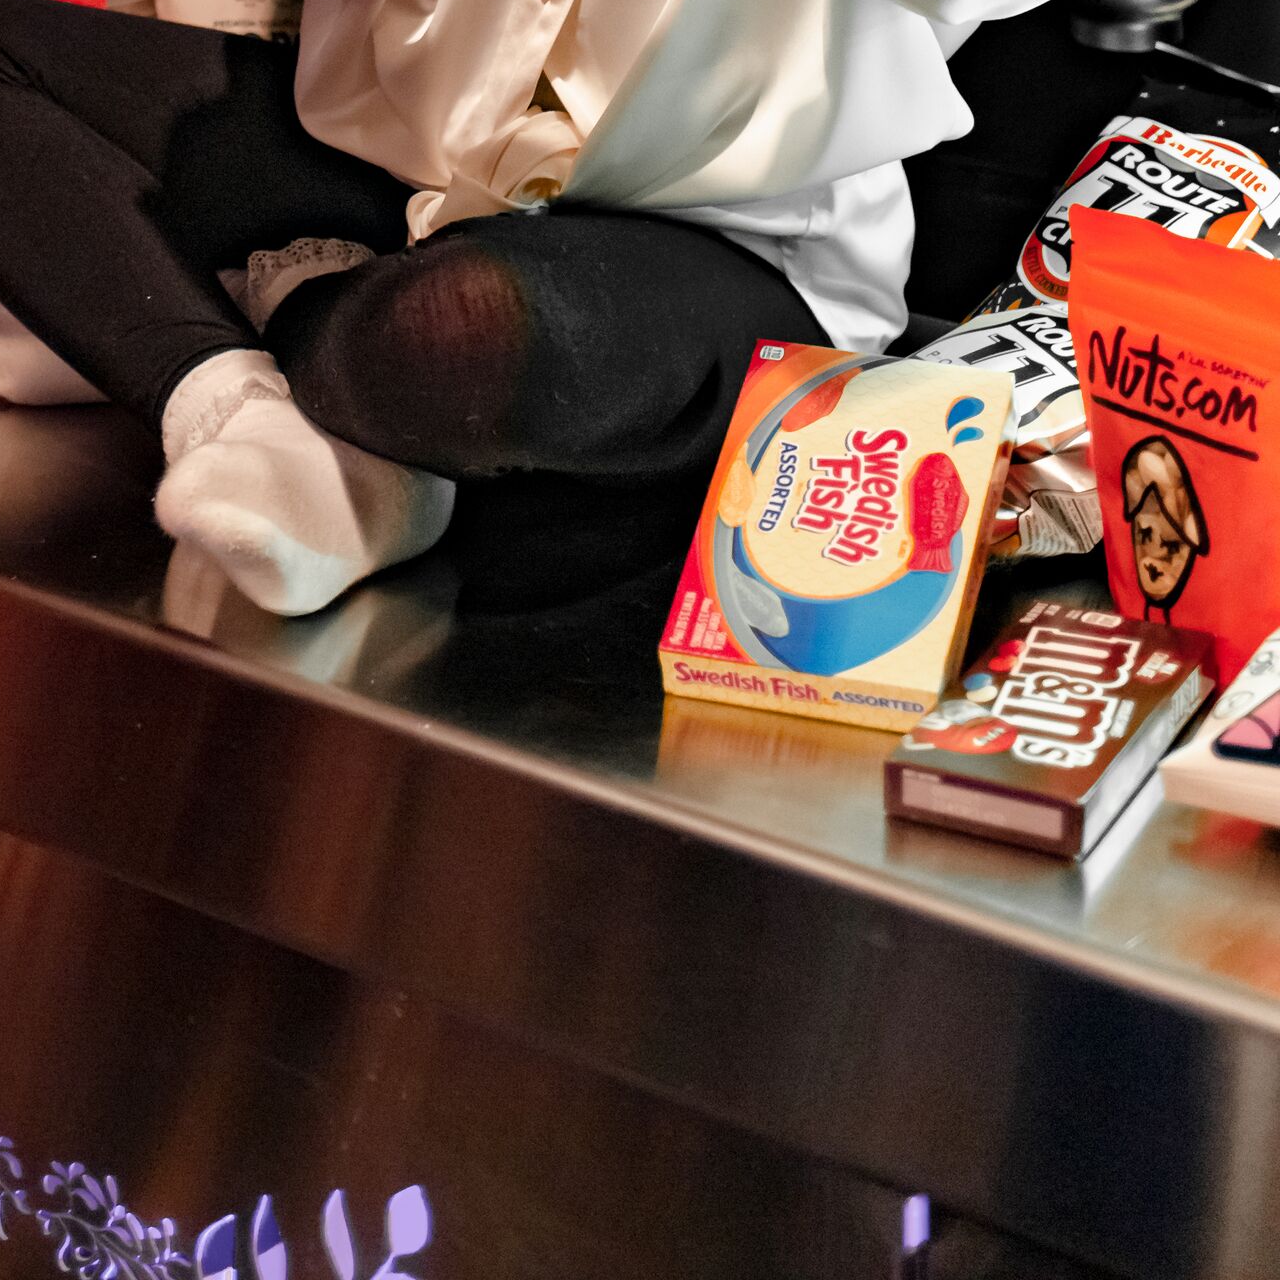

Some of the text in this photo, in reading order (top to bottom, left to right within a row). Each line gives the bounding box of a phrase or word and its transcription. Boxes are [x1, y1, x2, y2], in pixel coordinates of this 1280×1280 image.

[1110, 144, 1239, 213] ROUTE
[1140, 124, 1268, 194] Barbeque
[1017, 317, 1076, 368] ROU
[758, 442, 798, 532] ASSORTED
[795, 455, 862, 531] Fish
[830, 429, 908, 563] Swedish
[674, 661, 925, 714] Swedish Fish ASSORTED
